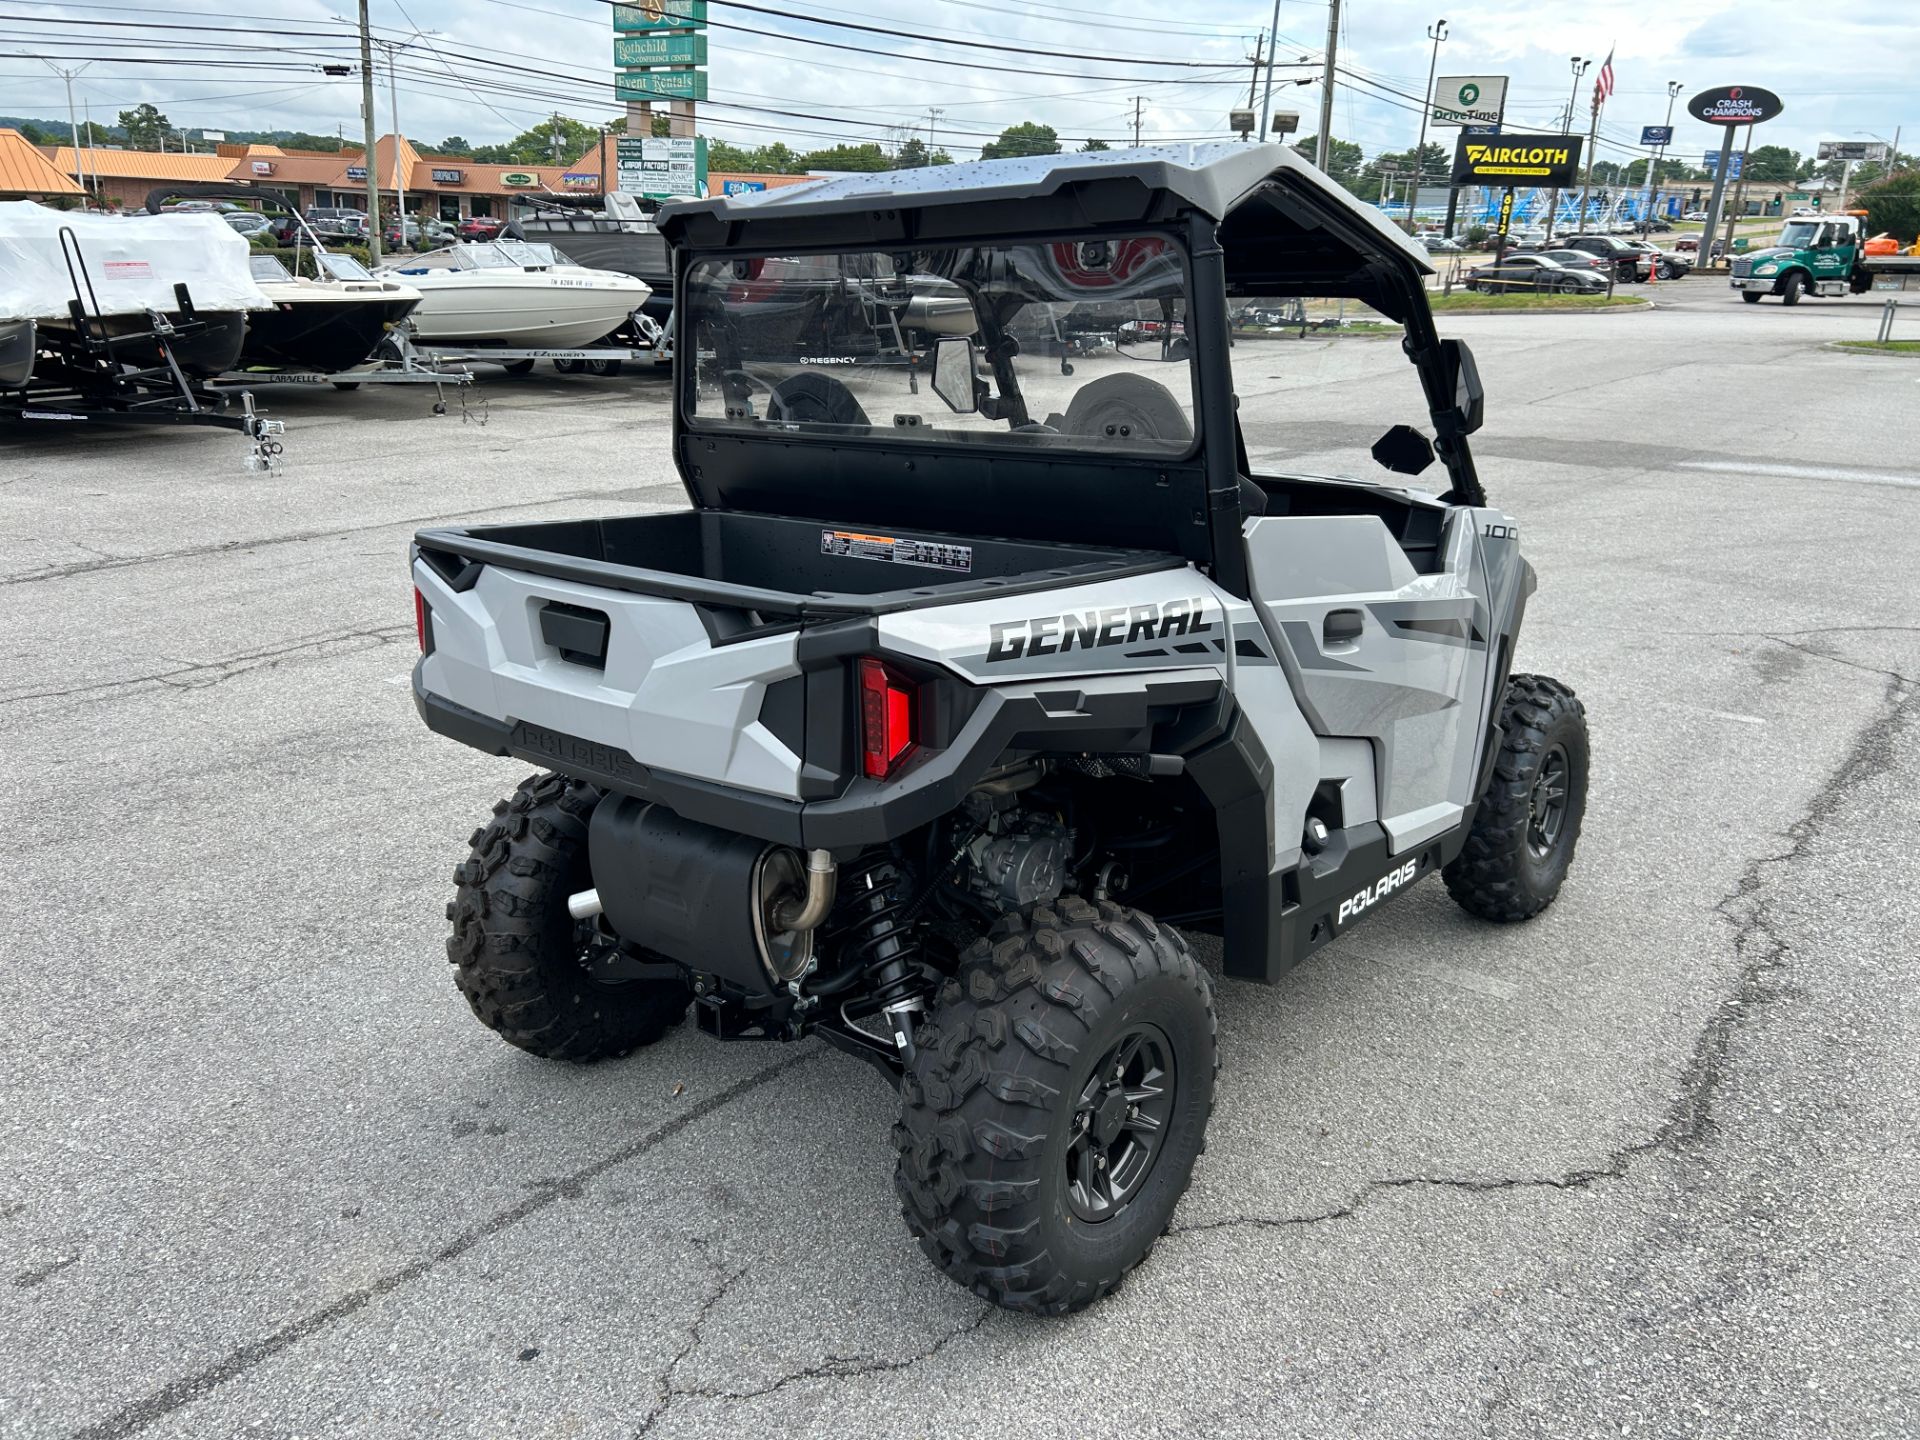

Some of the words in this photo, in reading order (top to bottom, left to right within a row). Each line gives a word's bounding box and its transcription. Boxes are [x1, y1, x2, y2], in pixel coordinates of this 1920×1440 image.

[616, 39, 667, 60] Rothchild
[636, 55, 669, 63] CONFERENCE
[671, 54, 692, 62] CENTER
[616, 74, 646, 89] Event
[652, 73, 693, 91] Rentals
[1702, 107, 1762, 116] CHAMPIONS
[1716, 99, 1752, 108] CRASH
[1433, 110, 1498, 120] DriveTime
[1466, 145, 1569, 165] FAIRCLOTH
[1498, 195, 1512, 234] 8812
[809, 356, 857, 364] REGENCY
[986, 597, 1212, 664] GENERAL
[521, 726, 634, 777] POLARIS
[1338, 857, 1417, 925] POLARIS
